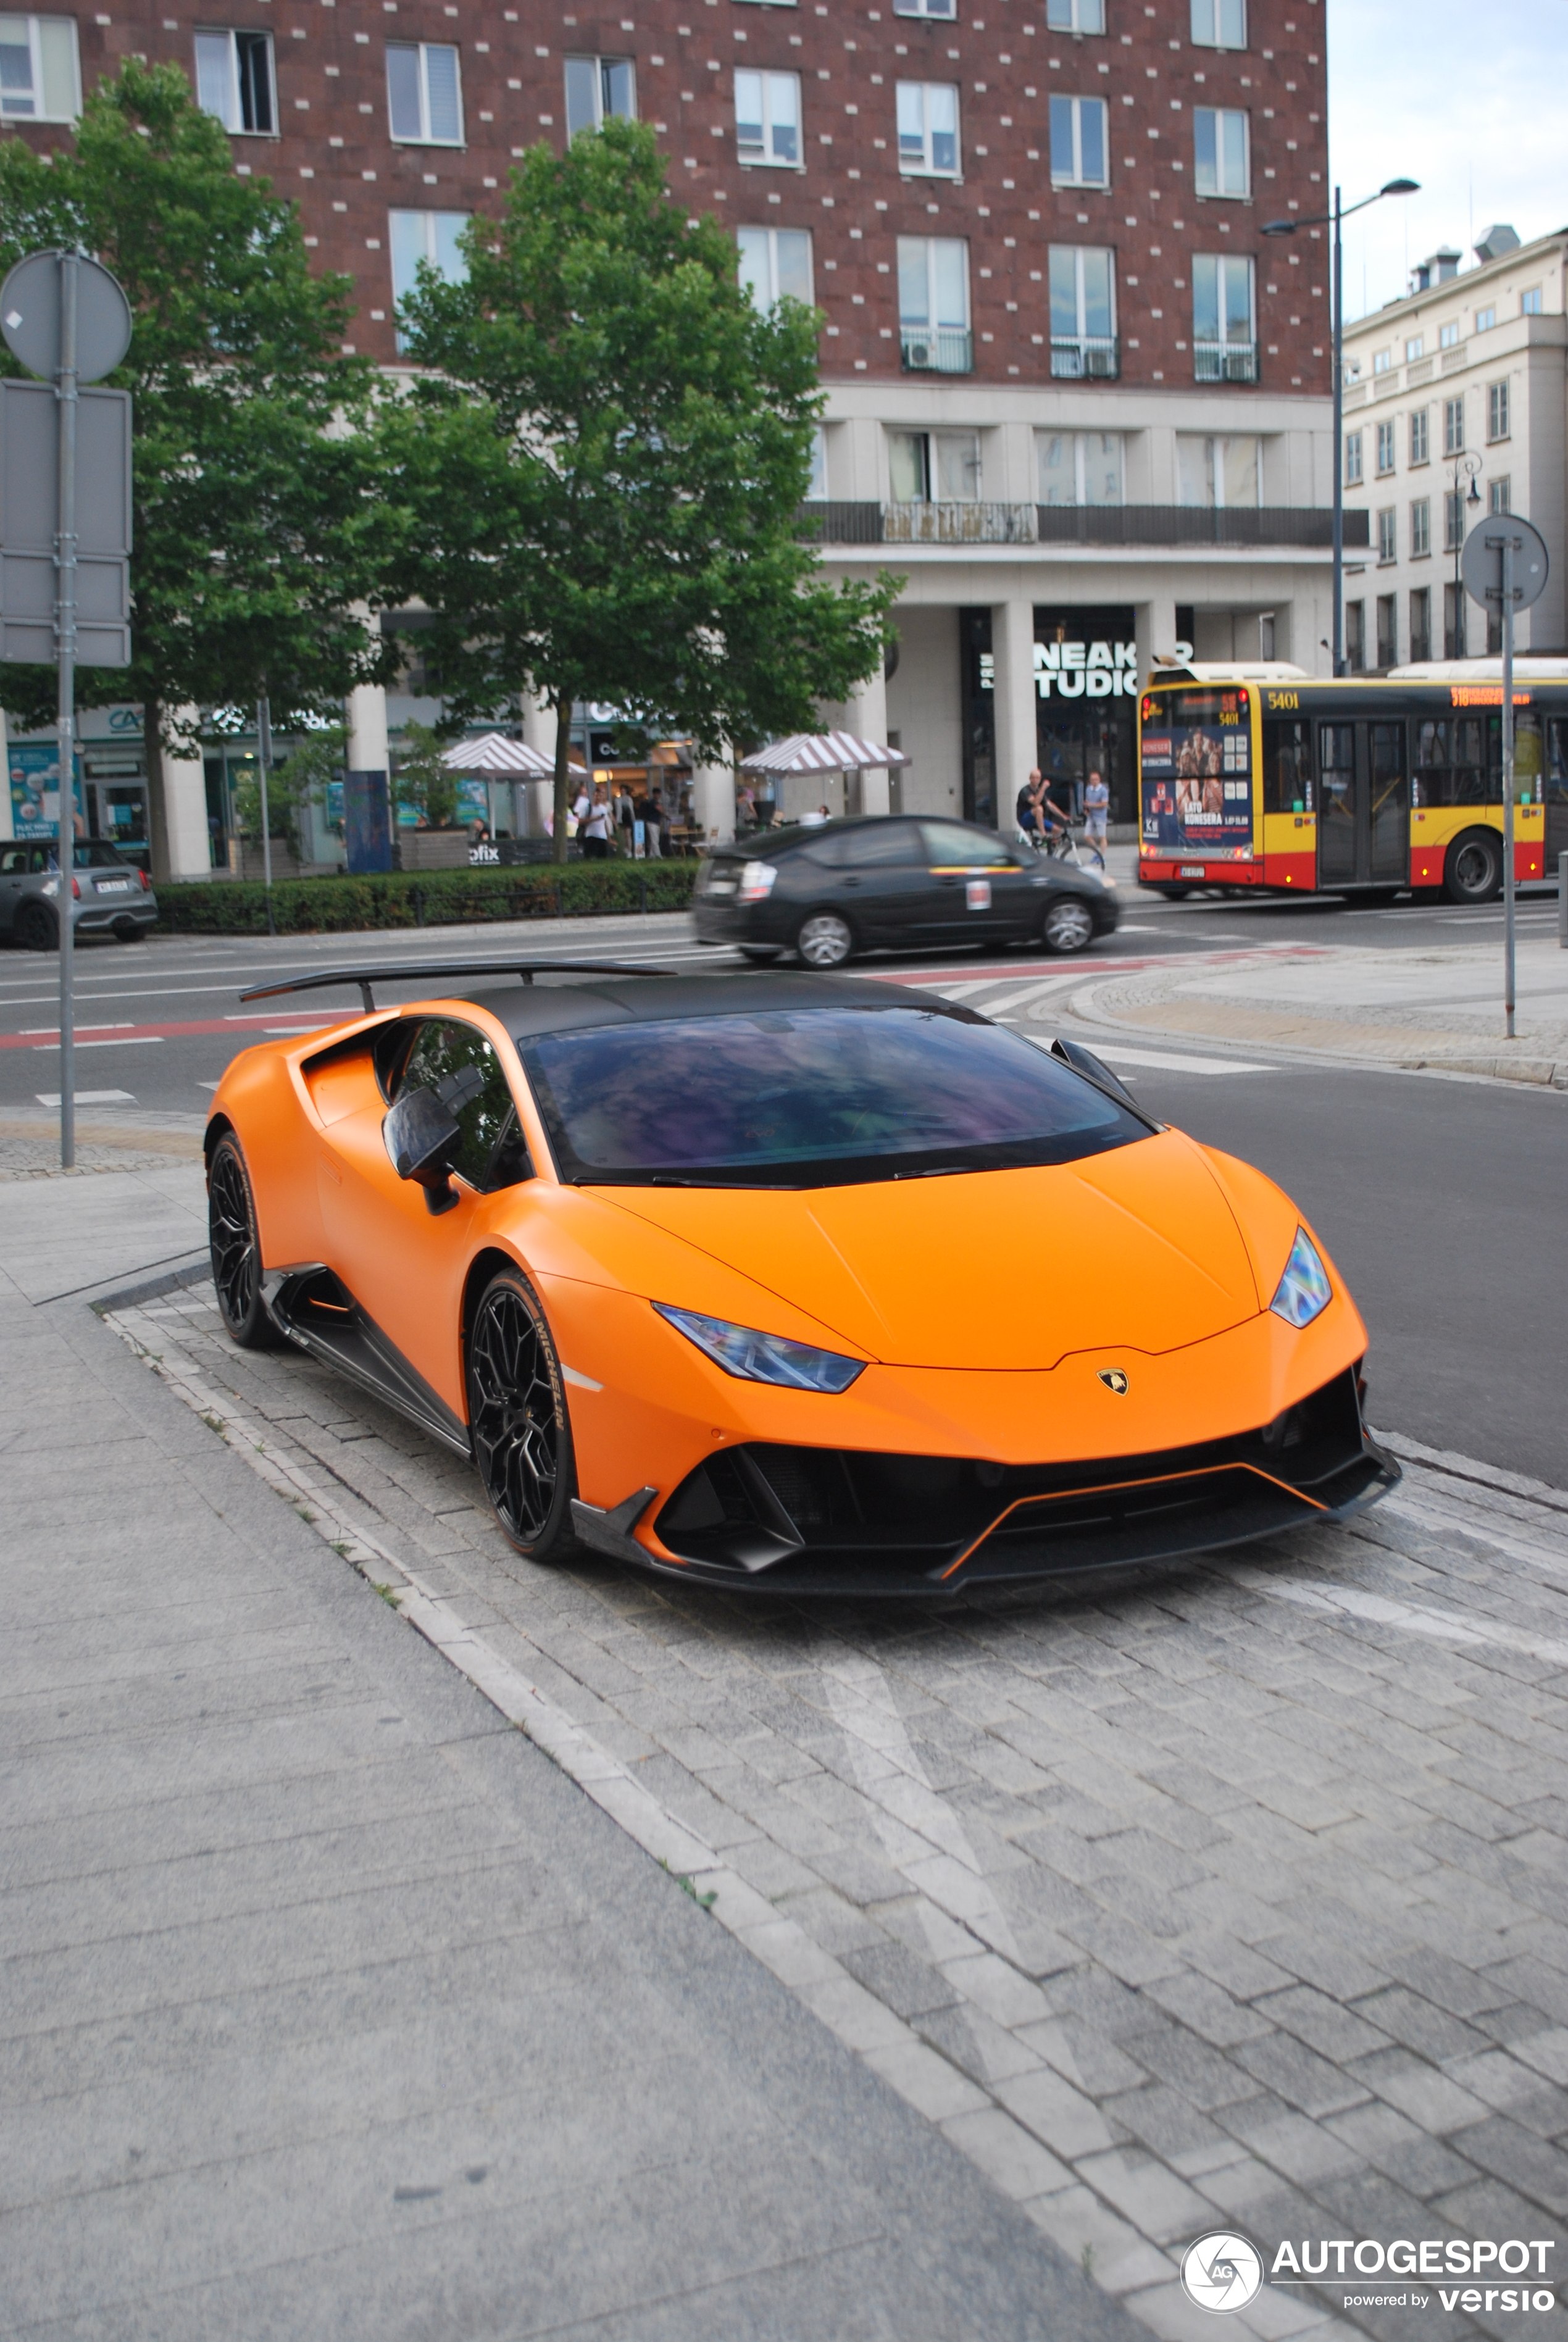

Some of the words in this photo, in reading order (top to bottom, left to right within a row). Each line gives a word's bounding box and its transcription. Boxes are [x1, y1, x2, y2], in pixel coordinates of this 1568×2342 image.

[1033, 641, 1194, 670] NEAKR
[1033, 669, 1137, 698] TUDI
[1268, 691, 1299, 710] 5401
[1451, 686, 1469, 707] 518
[1219, 711, 1239, 727] 5401
[1185, 801, 1203, 814] LATO
[1185, 813, 1222, 825] KONESERA
[469, 844, 500, 861] ofix
[536, 1321, 564, 1431] MICHELIN
